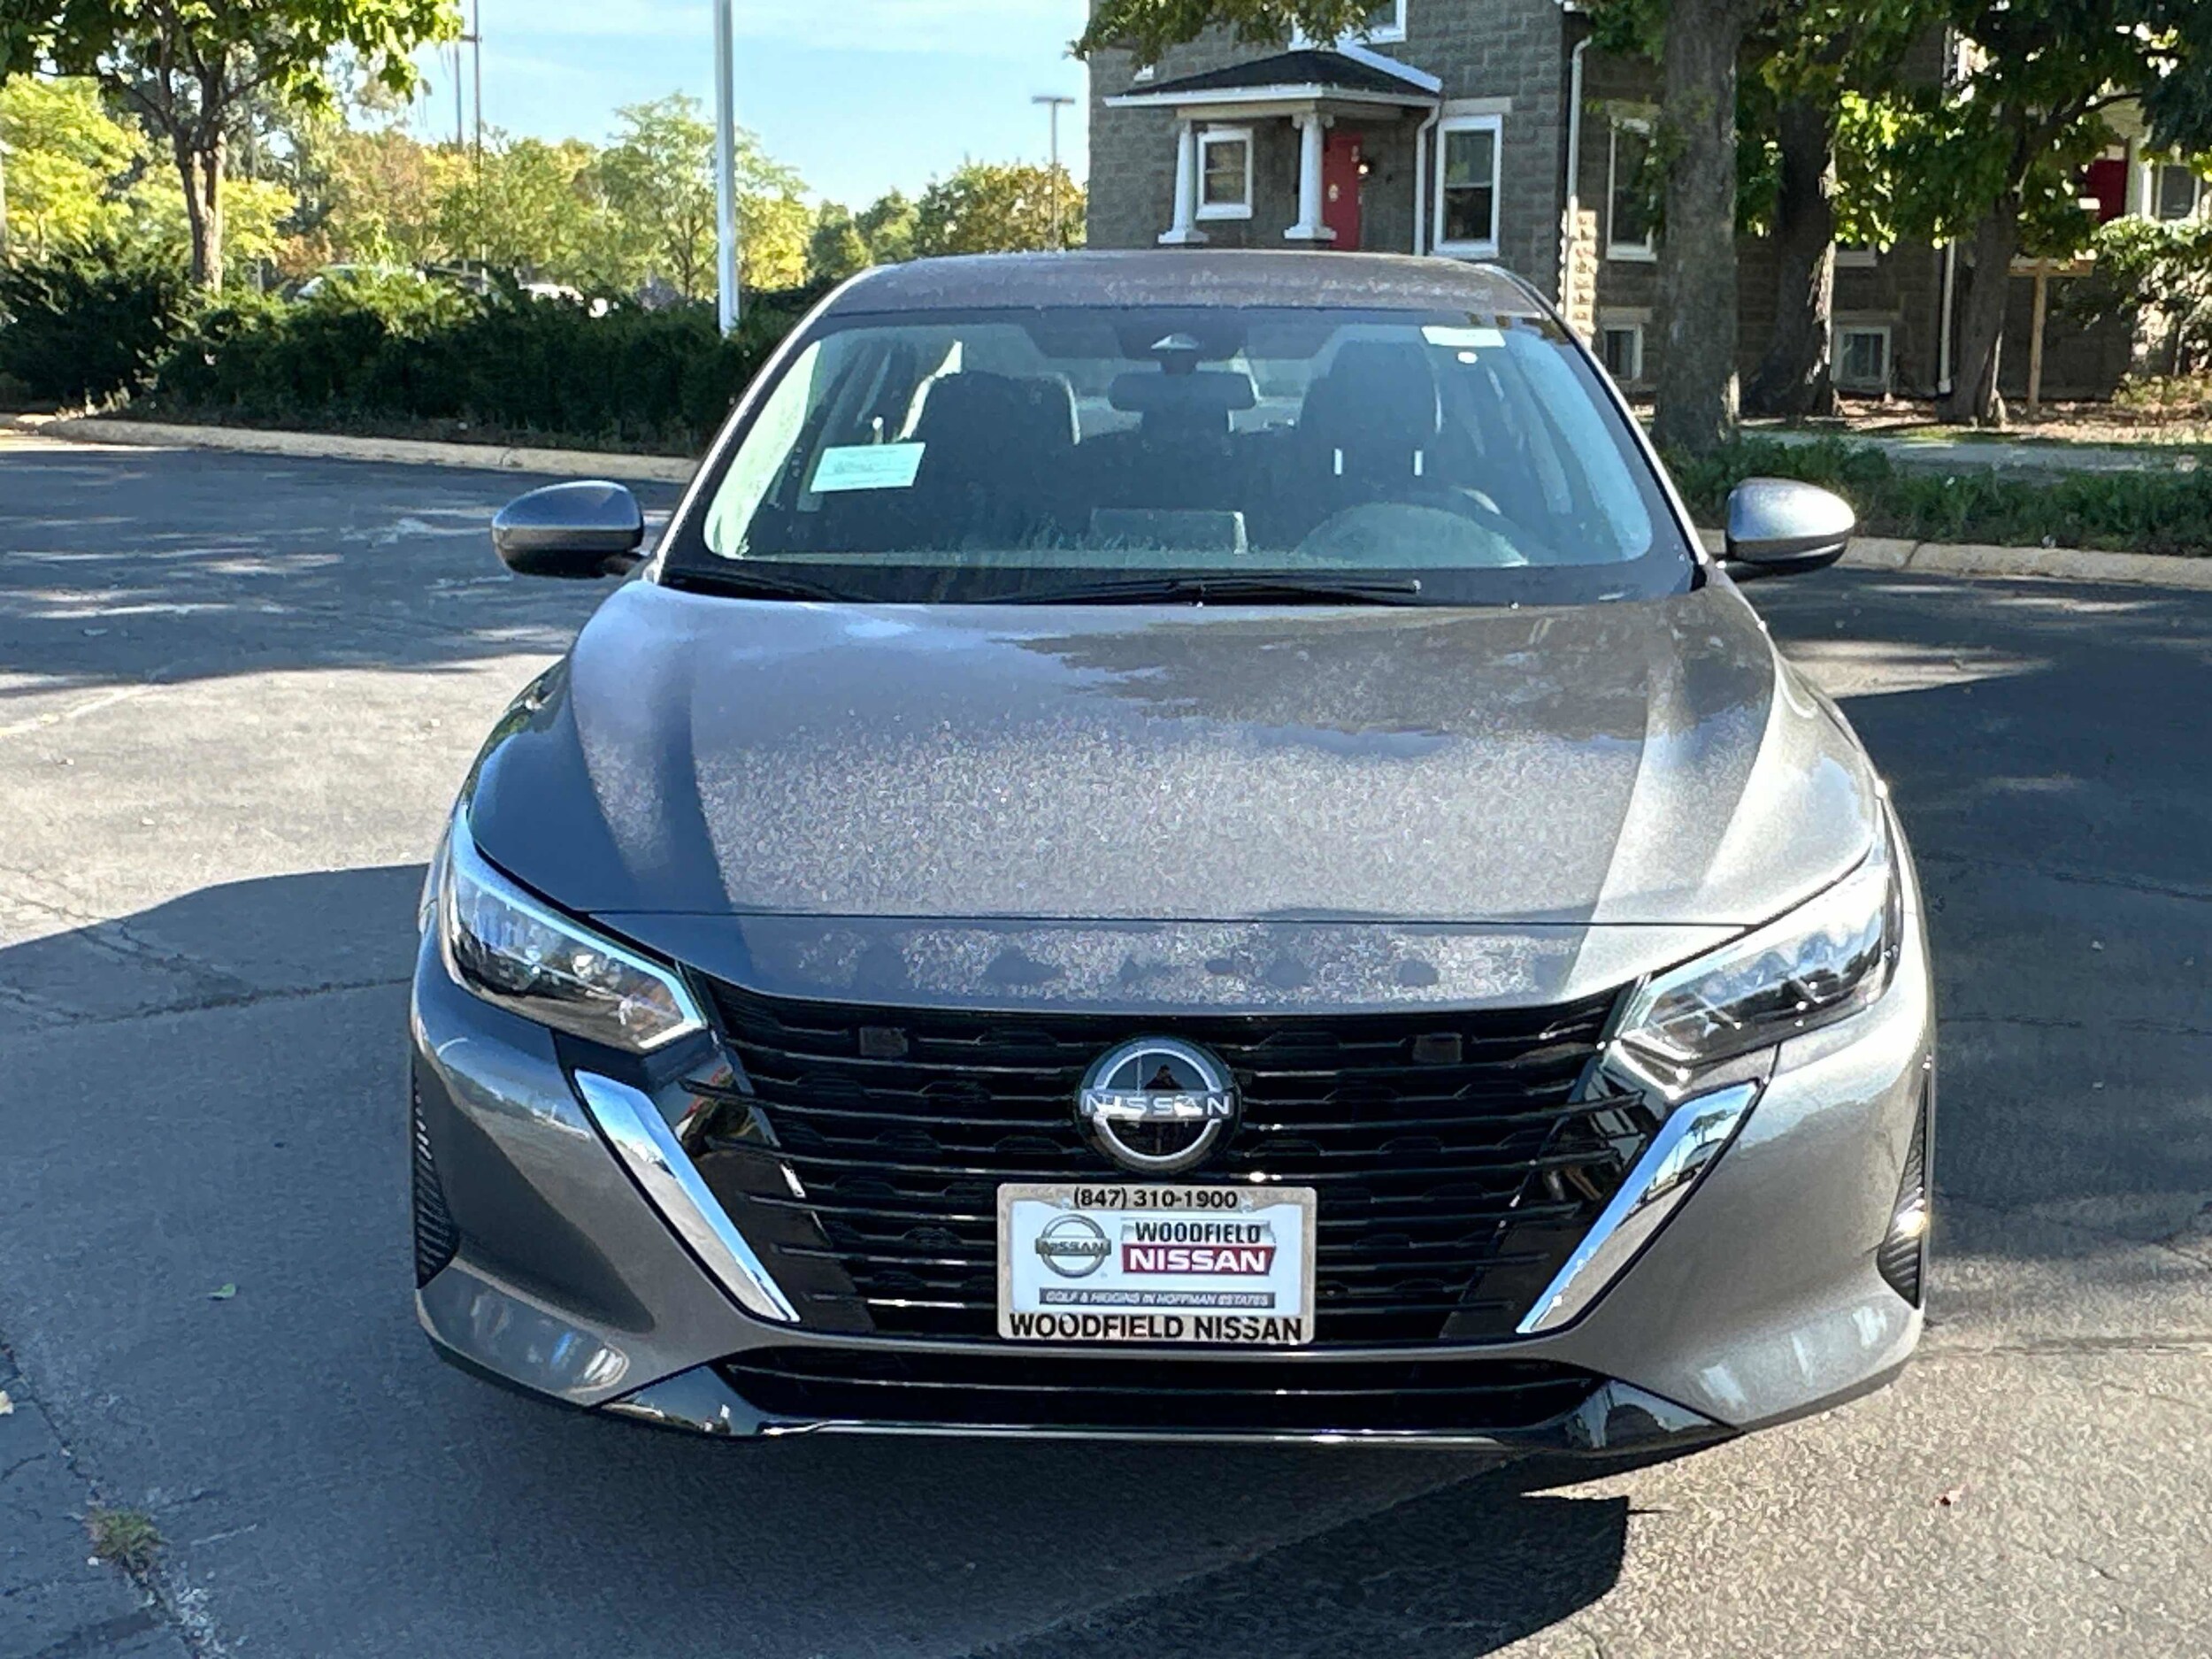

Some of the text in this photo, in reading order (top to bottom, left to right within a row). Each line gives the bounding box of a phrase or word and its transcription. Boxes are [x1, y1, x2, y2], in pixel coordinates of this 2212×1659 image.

[1086, 1093, 1230, 1116] NISSAN
[1073, 1187, 1238, 1209] (847) 310-1900
[1134, 1220, 1261, 1244] WOODFIELD
[1041, 1239, 1104, 1251] NISSAN
[1130, 1248, 1265, 1272] NISSAN
[1010, 1313, 1302, 1341] WOODFIELD NISSAN
